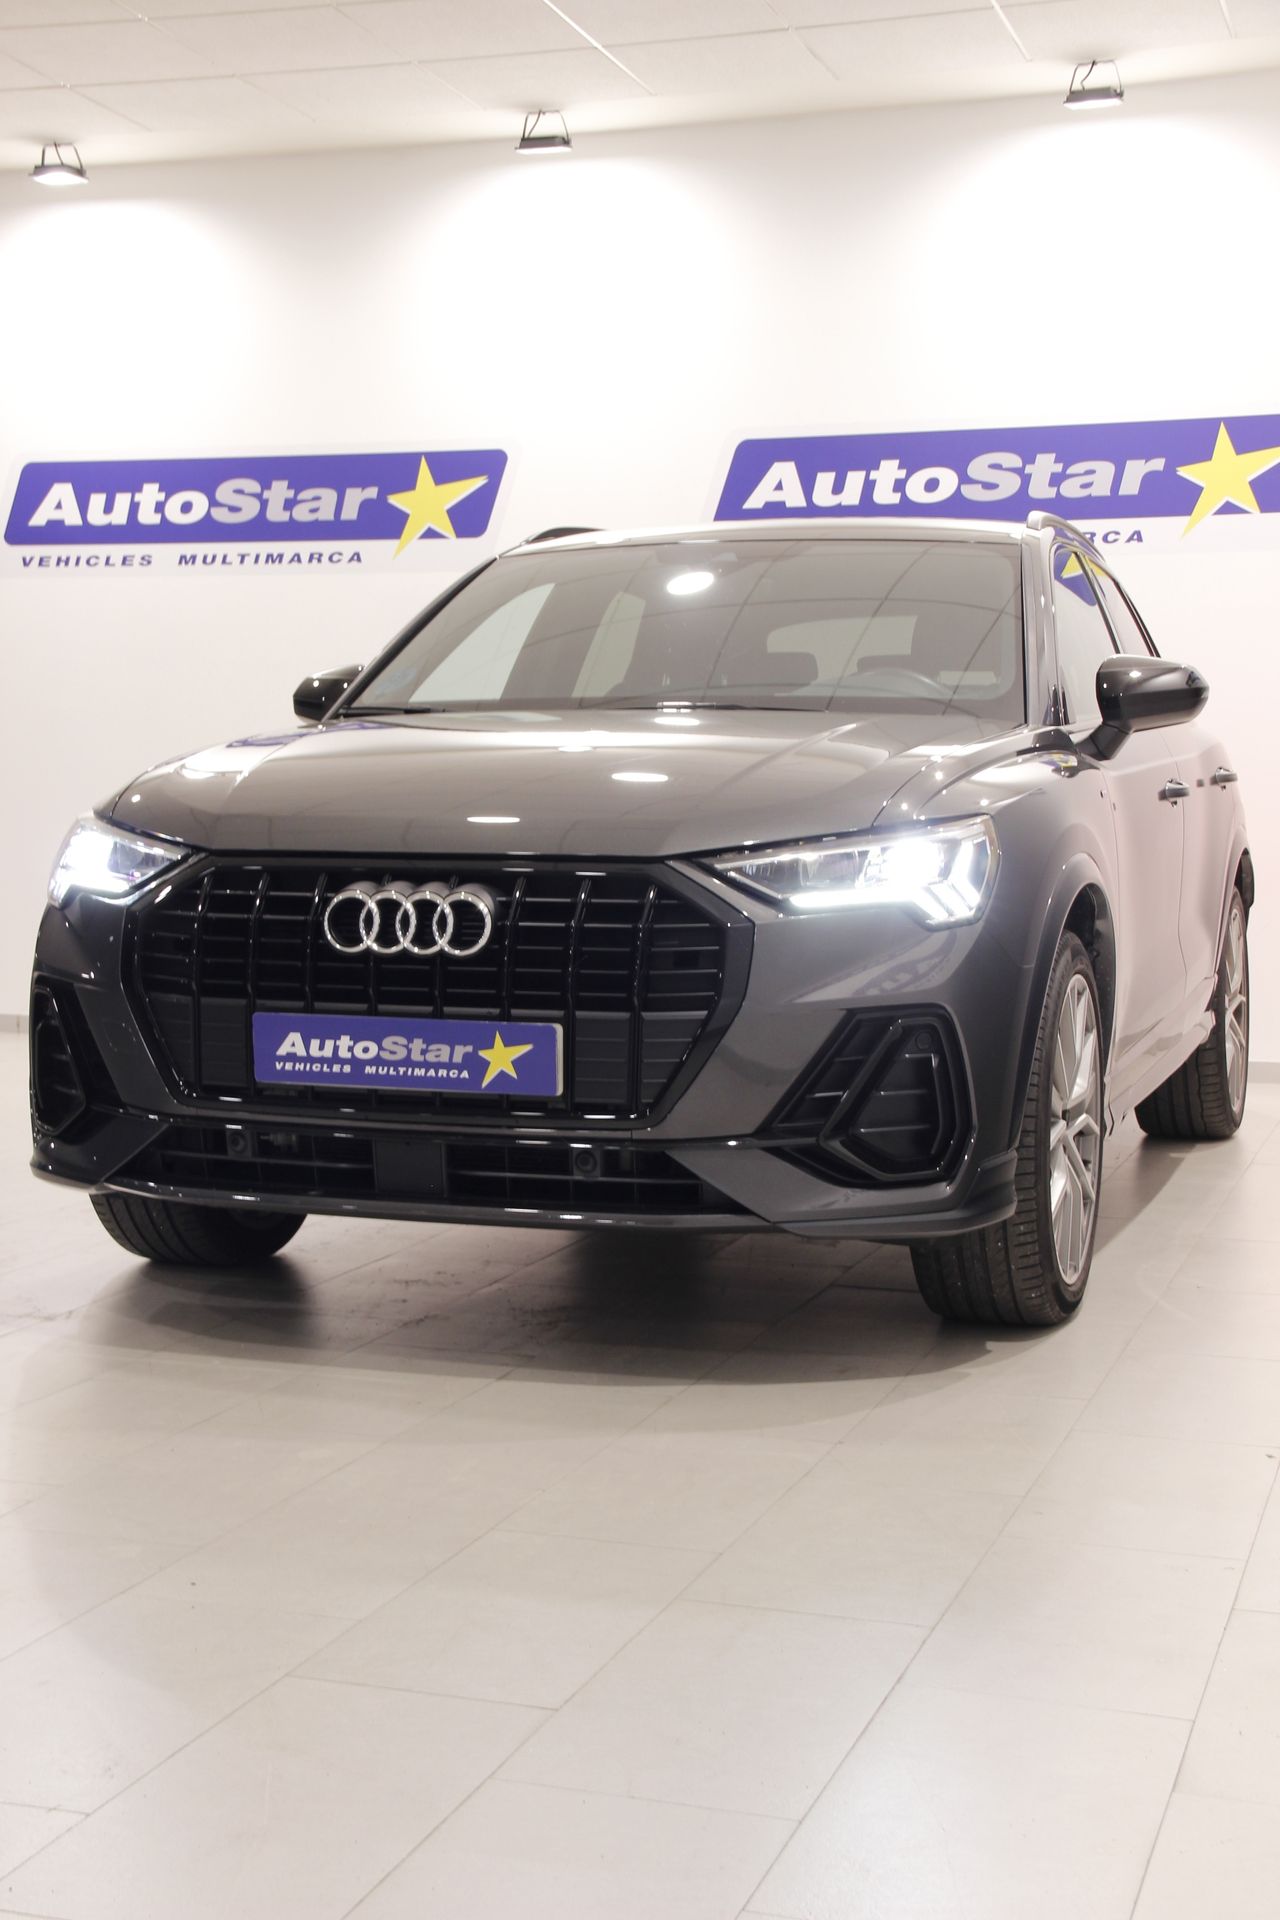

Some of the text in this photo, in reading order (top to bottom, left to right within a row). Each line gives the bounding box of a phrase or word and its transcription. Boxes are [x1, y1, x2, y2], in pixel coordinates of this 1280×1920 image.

[742, 451, 1166, 510] AutoStar
[28, 477, 379, 527] AutoStar
[21, 551, 364, 567] VEHICLES MULTIMARCA
[275, 1031, 473, 1063] AutoStar
[275, 1061, 470, 1079] VEHICLES MULTIMARCA
